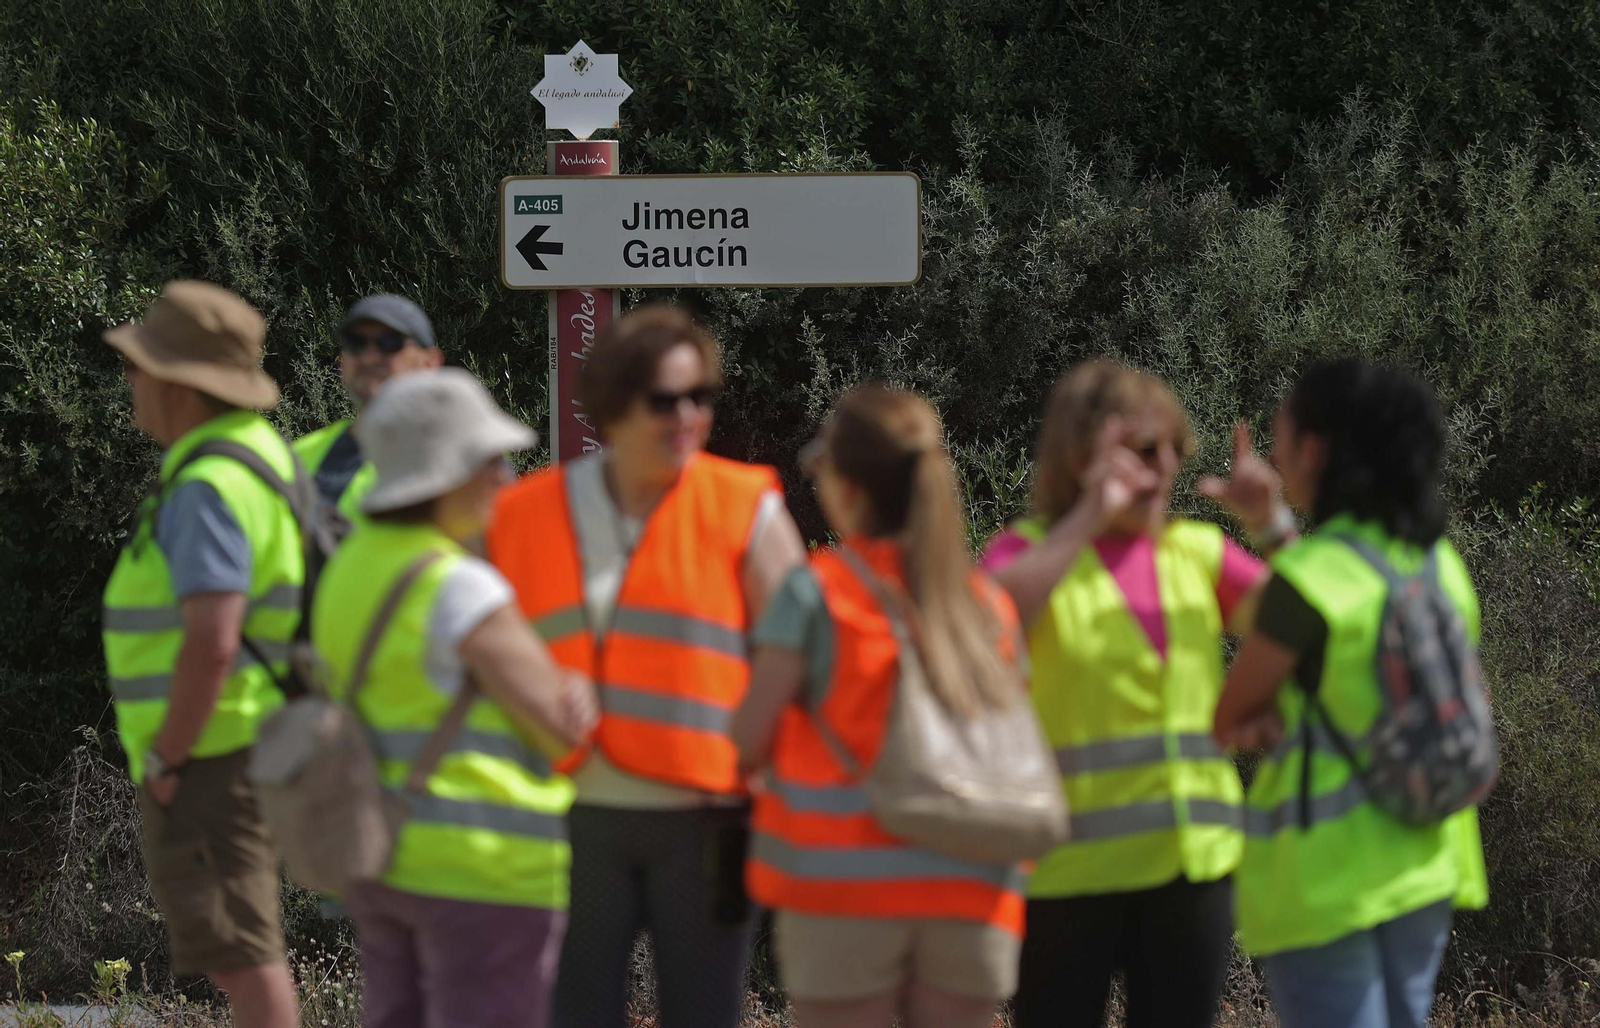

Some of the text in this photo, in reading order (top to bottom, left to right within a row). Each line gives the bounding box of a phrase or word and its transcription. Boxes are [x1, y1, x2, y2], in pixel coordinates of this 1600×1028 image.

[538, 89, 550, 98] El
[551, 89, 581, 100] legado
[560, 152, 607, 166] Andalucía
[518, 199, 559, 212] A-405
[621, 201, 750, 231] Jimena
[622, 238, 748, 268] Gaucín
